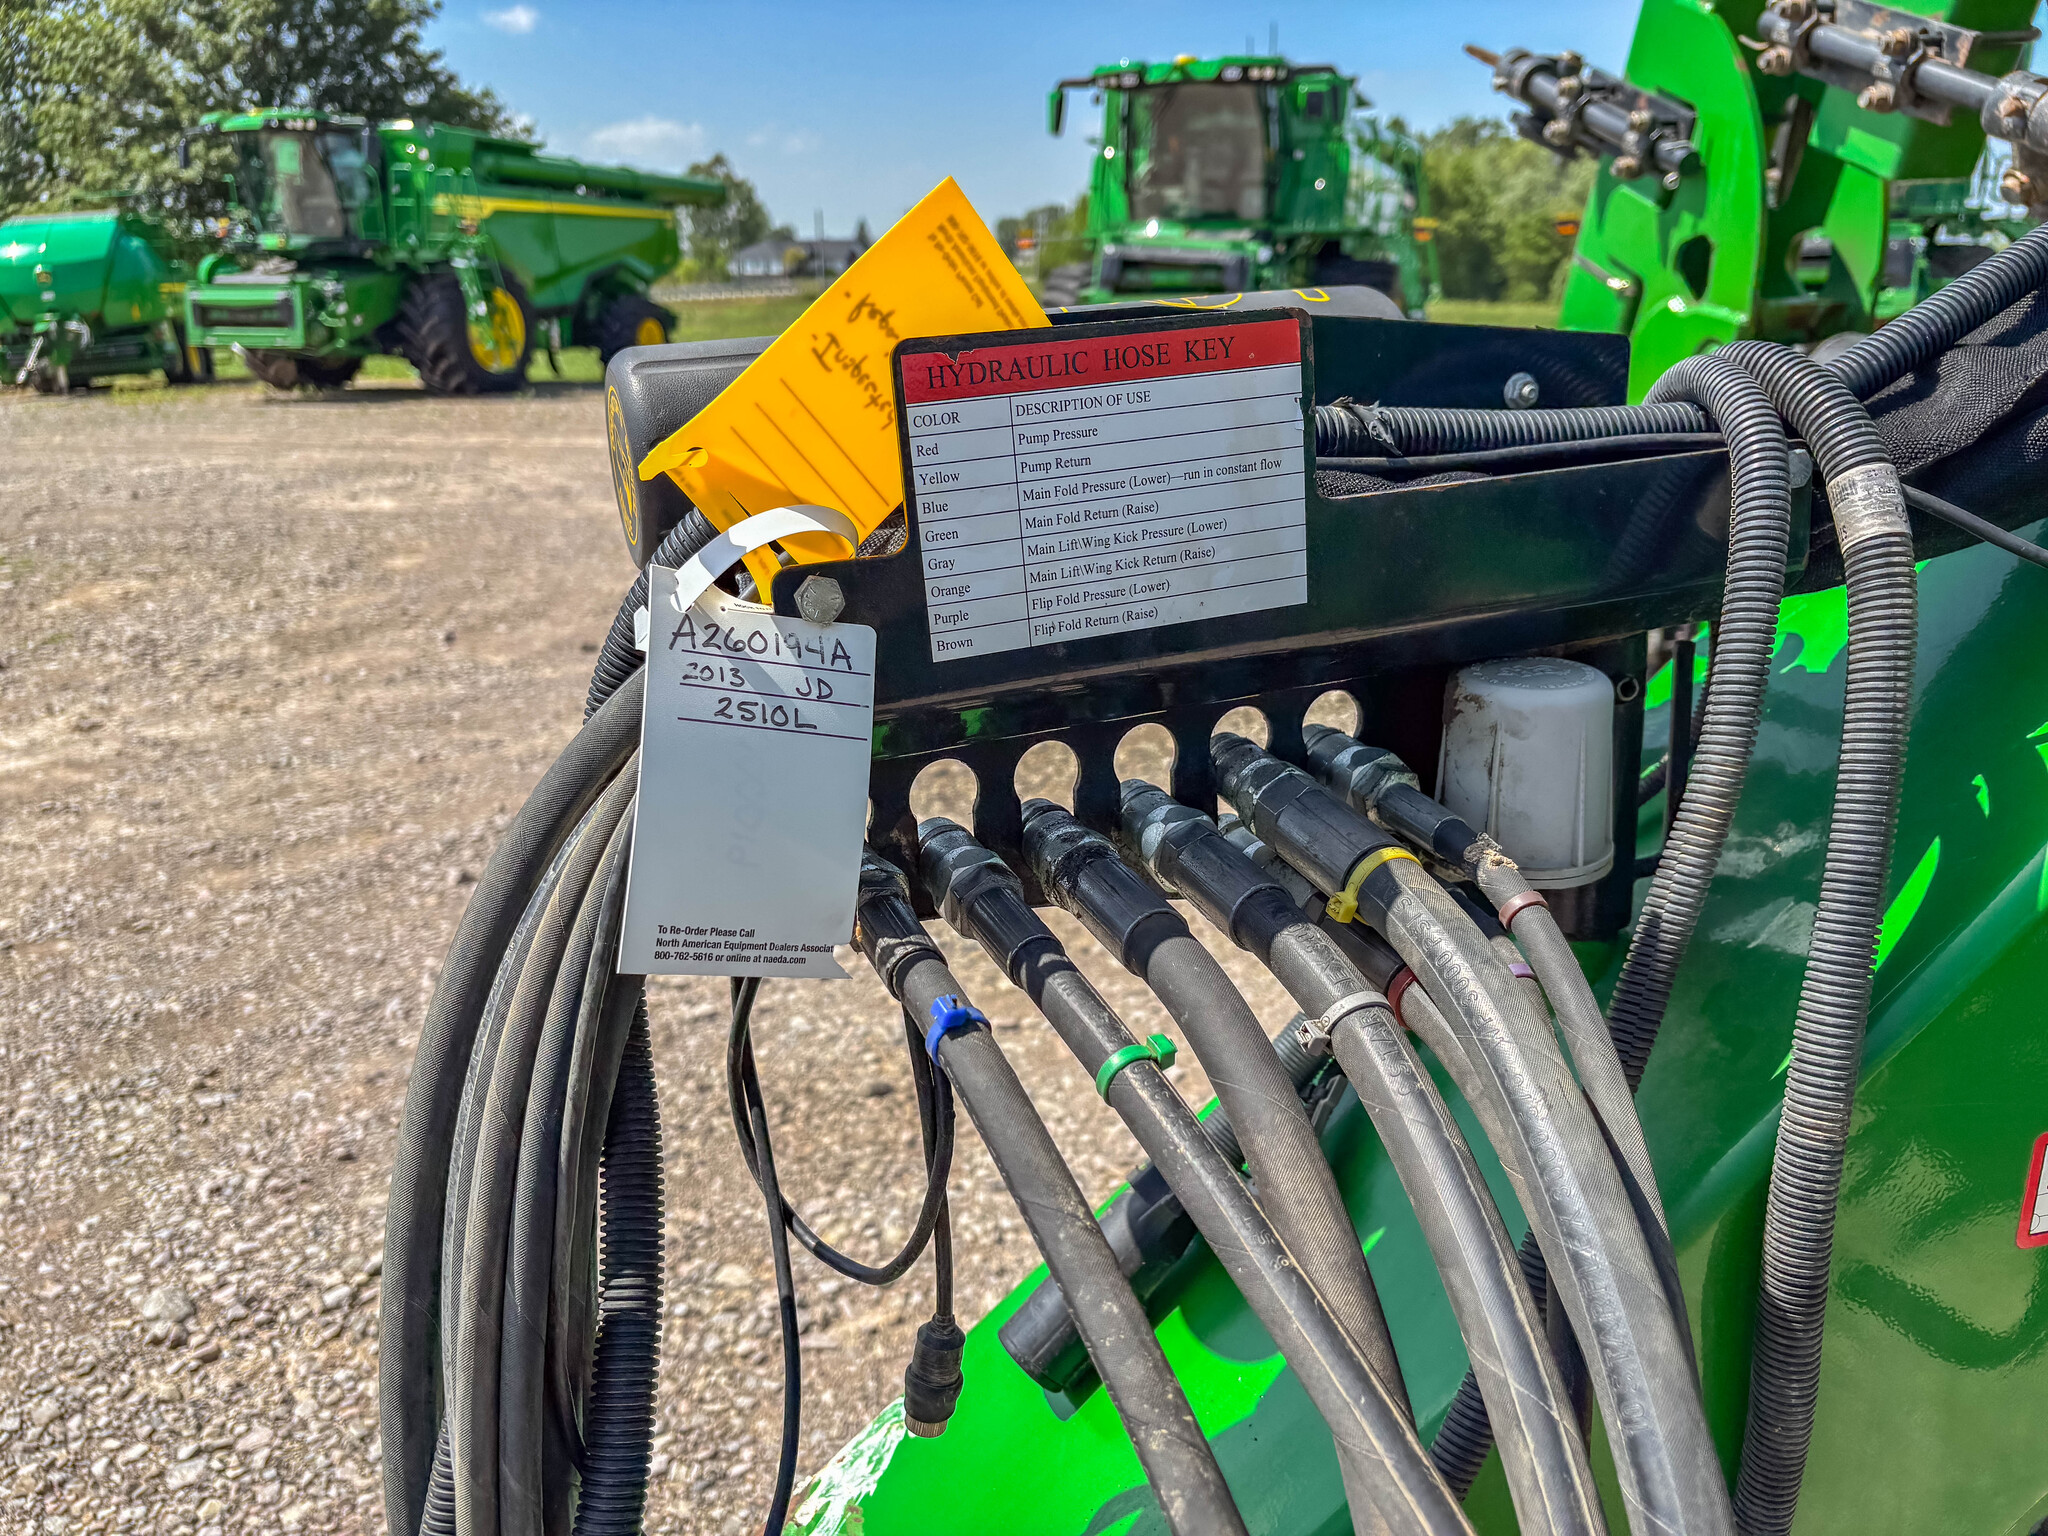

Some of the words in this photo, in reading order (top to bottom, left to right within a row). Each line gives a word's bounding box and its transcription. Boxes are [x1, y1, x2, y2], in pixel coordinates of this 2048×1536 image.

[926, 352, 1088, 389] HYDRAULIC
[1104, 343, 1170, 371] HOSE
[1184, 337, 1234, 362] KEY
[1016, 396, 1102, 416] DESCRIPTION
[1106, 394, 1122, 406] OF
[1126, 391, 1151, 404] USE
[914, 412, 960, 428] COLOR
[1018, 434, 1049, 446] Pump
[1053, 428, 1098, 441] Pressure
[917, 443, 939, 456] Red
[1020, 462, 1052, 474] Pump
[1055, 457, 1091, 469] Return
[920, 472, 960, 485] Yellow
[1023, 488, 1051, 501] Main
[1054, 483, 1078, 500] Fold
[1082, 480, 1126, 494] Pressure
[1204, 466, 1213, 478] in
[1216, 462, 1257, 476] constant
[1260, 458, 1282, 470] flow
[922, 501, 948, 514] Blue
[1025, 515, 1053, 529] Main
[1056, 511, 1080, 525] Fold
[1084, 509, 1118, 521] Return
[1122, 500, 1158, 518] (Raise)
[926, 531, 958, 542] Green
[1028, 543, 1055, 556] Main
[1114, 530, 1138, 544] Kick
[1142, 527, 1184, 540] Pressure
[1187, 518, 1227, 536] (Lower)
[928, 559, 955, 570] Gray
[1030, 570, 1057, 583] Main
[1116, 557, 1140, 571] Kick
[1143, 555, 1176, 566] Return
[1180, 546, 1215, 563] (Raise)
[931, 585, 970, 597] Orange
[1032, 597, 1053, 611] Flip
[1056, 592, 1080, 606] Fold
[1083, 589, 1126, 602] Pressure
[1129, 579, 1171, 597] (Lower)
[934, 610, 969, 625] Purple
[1034, 622, 1056, 636] Flip
[1058, 618, 1081, 632] Fold
[1085, 616, 1119, 628] Return
[1122, 606, 1158, 624] (Raise)
[669, 613, 853, 671] A260194A
[937, 639, 973, 651] Brown
[682, 662, 746, 688] 2013
[796, 677, 833, 700] JD
[714, 697, 817, 730] 2510L
[658, 925, 668, 934] To
[670, 926, 709, 936] Re-Order
[710, 927, 737, 938] Please
[739, 928, 755, 938] Call
[656, 938, 680, 948] North
[681, 939, 722, 950] American
[723, 940, 768, 952] Equipment
[769, 942, 799, 952] Dealers
[654, 951, 714, 962] 800-762-5616
[715, 954, 724, 962] or
[726, 954, 751, 963] online
[752, 955, 762, 963] at
[763, 955, 806, 964] naeda.com
[1432, 949, 1480, 1009] 3000
[1319, 960, 1411, 1080] STARLEX
